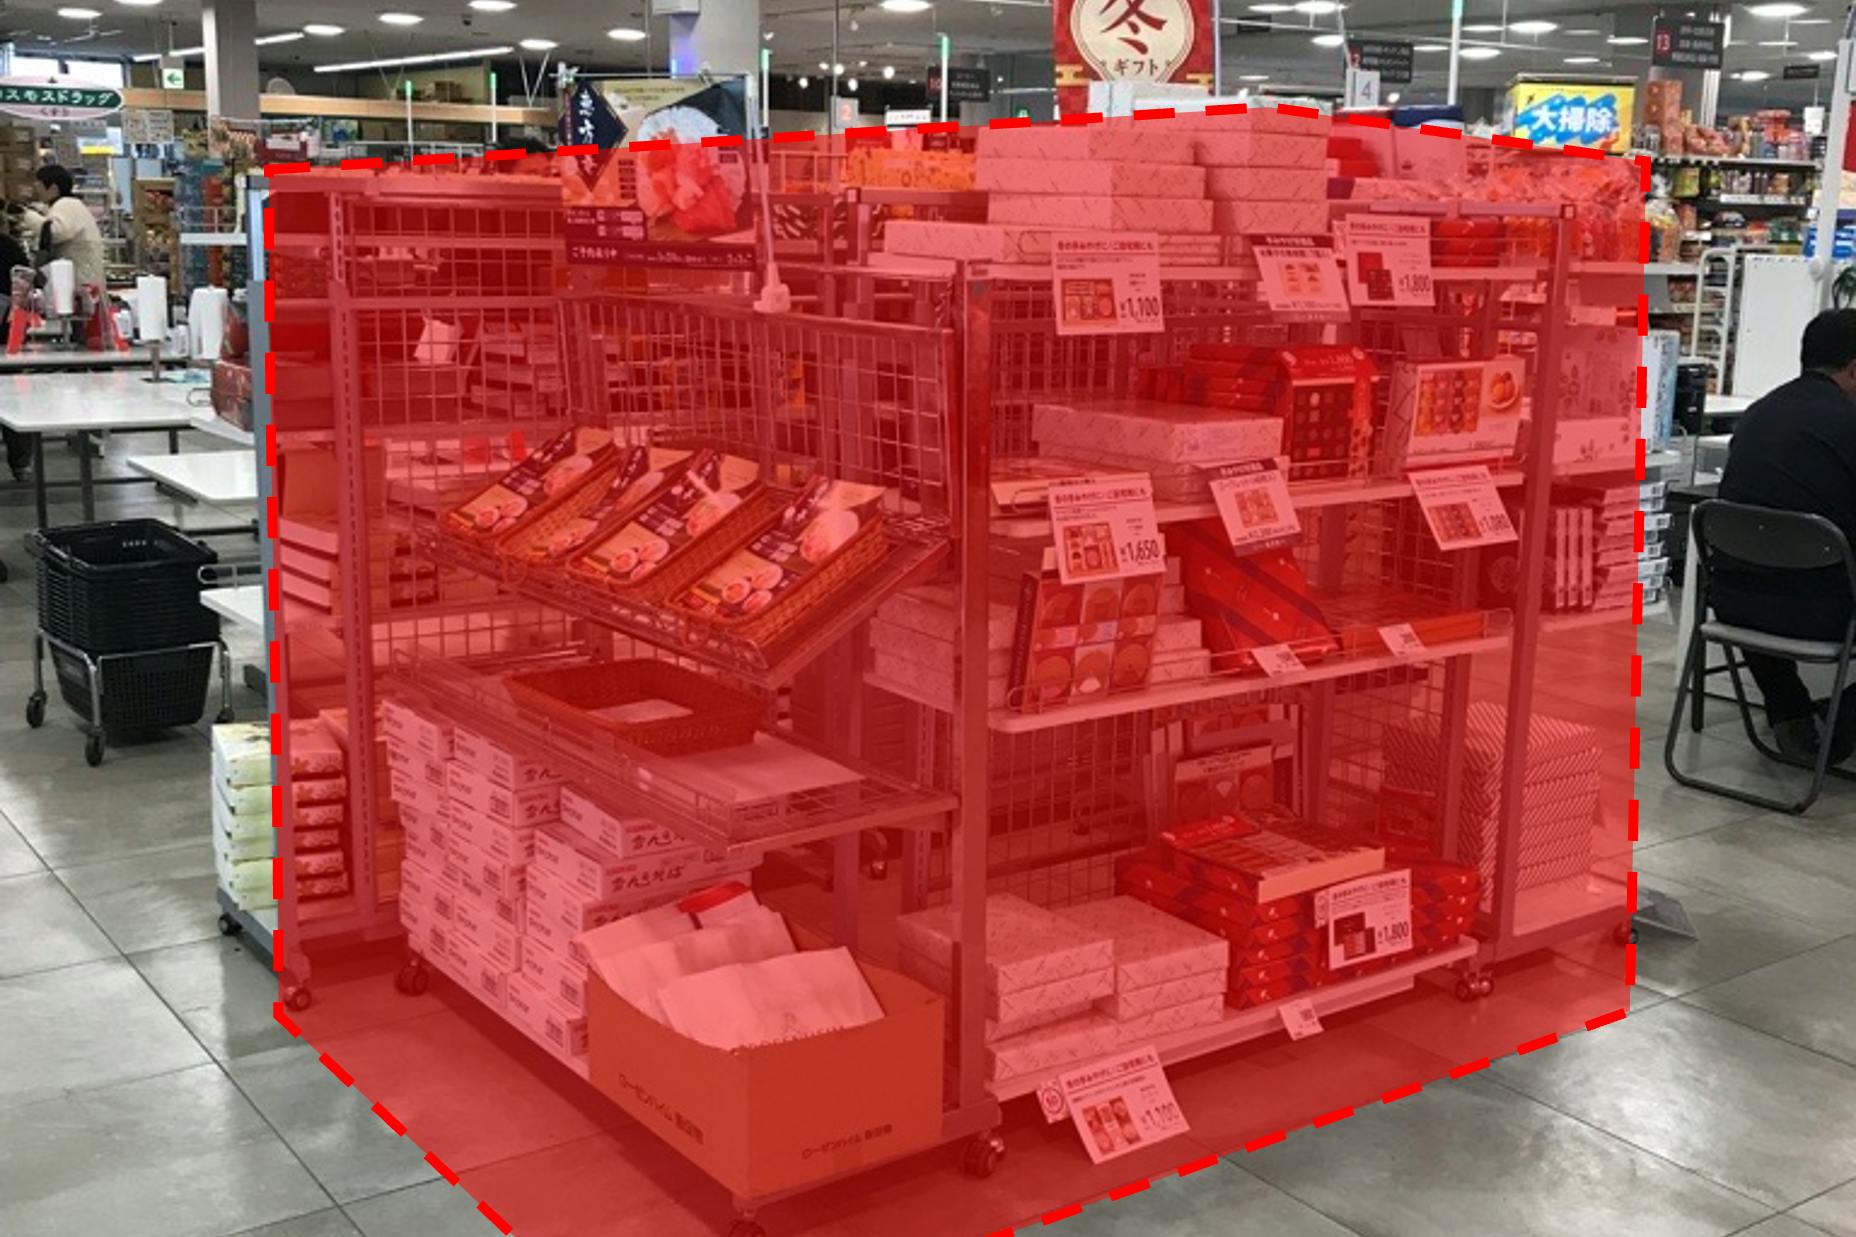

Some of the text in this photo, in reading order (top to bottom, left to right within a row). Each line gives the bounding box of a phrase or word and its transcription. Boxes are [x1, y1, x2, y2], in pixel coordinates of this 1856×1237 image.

[1100, 0, 1168, 55] 冬
[1657, 34, 1671, 51] 13
[1114, 58, 1159, 76] ギフト
[0, 88, 114, 106] スモスドラッグ
[1361, 80, 1372, 101] 4
[1532, 104, 1613, 134] 大掃除
[1120, 538, 1160, 562] ¥1,650
[617, 1073, 679, 1122] ローゼンハイム
[801, 1133, 862, 1160] ローゼンハイム
